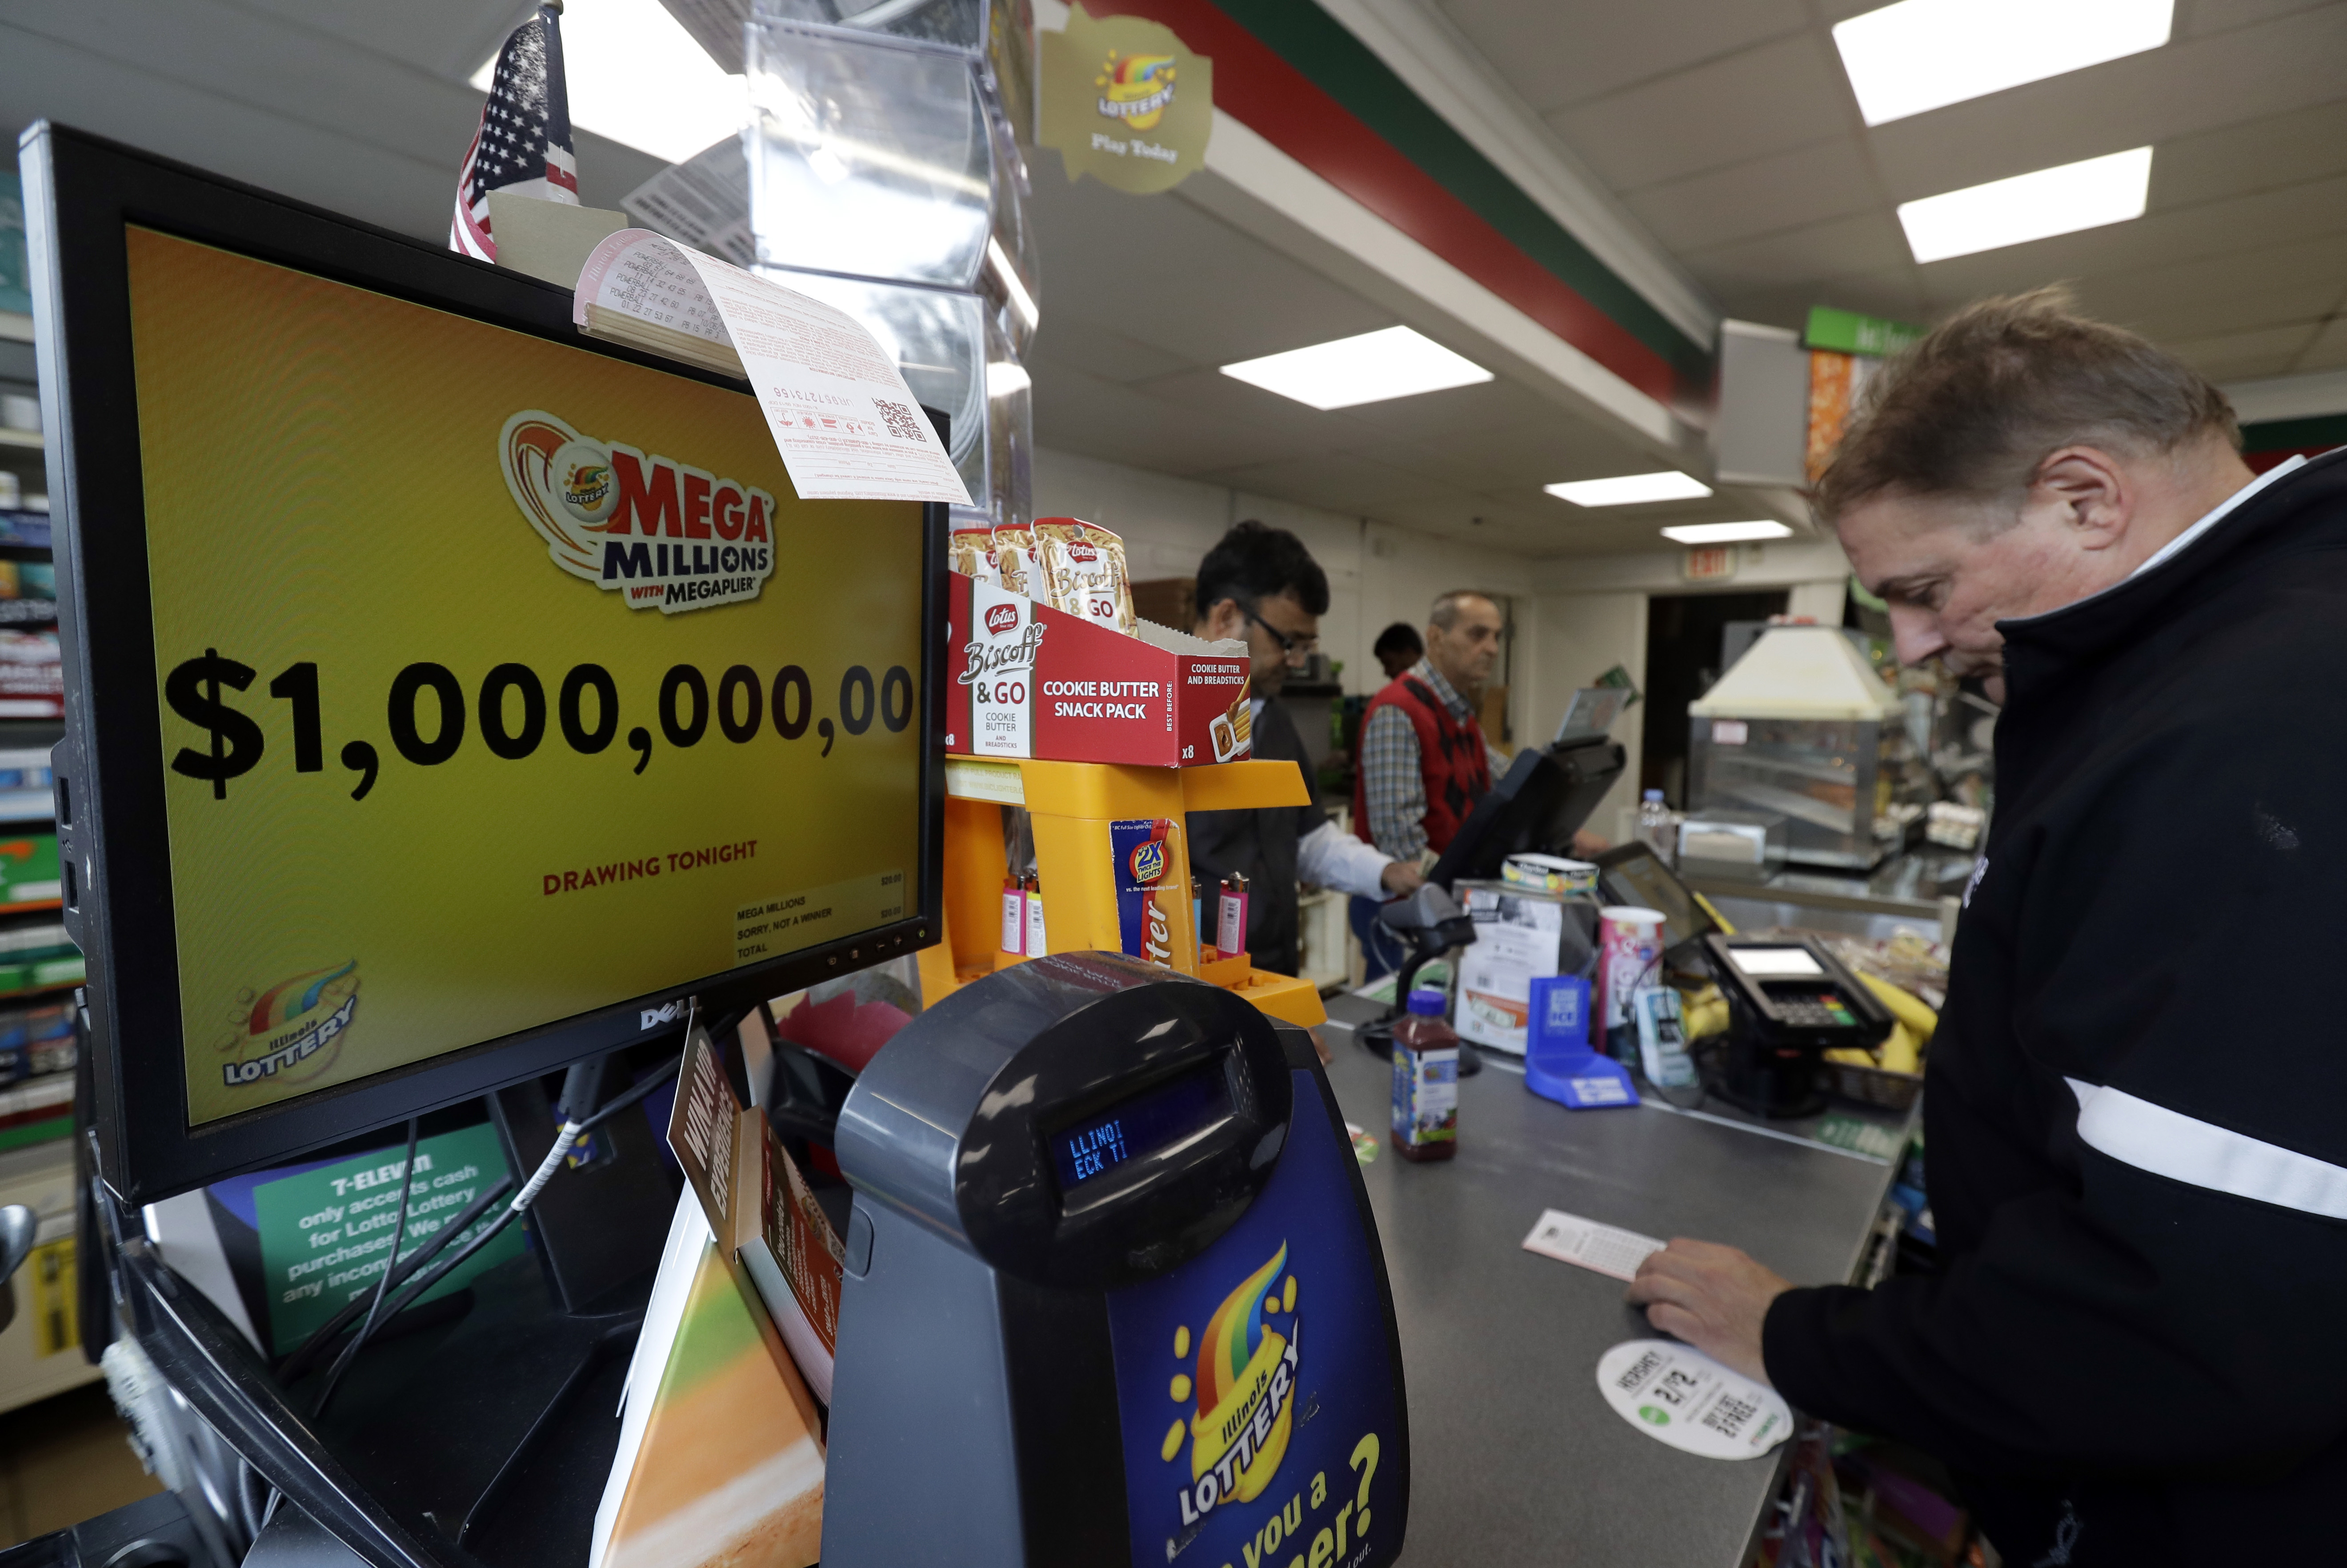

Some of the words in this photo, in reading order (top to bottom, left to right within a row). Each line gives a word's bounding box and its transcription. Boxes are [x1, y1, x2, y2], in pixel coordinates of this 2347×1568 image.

[1092, 133, 1128, 156] Play
[1130, 139, 1178, 164] Today
[589, 250, 613, 282] Illinois
[624, 261, 658, 279] POWERBALL
[633, 251, 668, 268] POWERBALL
[616, 272, 650, 291] POWERBALL
[656, 280, 666, 288] 32
[693, 294, 703, 302] PB
[609, 288, 644, 305] POWERBALL
[648, 293, 658, 301] 27
[687, 307, 696, 315] PB
[697, 310, 706, 318] 07
[632, 304, 641, 312] 22
[644, 308, 653, 316] 27
[654, 312, 663, 320] 53
[665, 315, 673, 324] 67
[681, 320, 690, 328] PB
[692, 324, 700, 332] 15
[566, 482, 609, 504] LOTTERY
[606, 450, 768, 543] MEGA
[602, 541, 768, 580] MILLIONS
[1071, 544, 1097, 557] Lotus
[1050, 560, 1121, 598] Biscoff
[630, 584, 665, 600] WITH
[665, 578, 754, 606] MEGAPLIER
[989, 606, 1016, 628] Lotus
[1086, 599, 1113, 618] GO
[957, 622, 1044, 685] Biscoff
[1187, 675, 1203, 685] AND
[1204, 676, 1245, 685] BREADSTICKS
[1191, 663, 1217, 674] COOKIE
[1218, 664, 1241, 674] BUTTER
[977, 682, 991, 704] &
[994, 681, 1025, 704] GO
[1043, 680, 1097, 696] COOKIE
[1100, 681, 1159, 698] BUTTER
[985, 712, 1017, 722] COOKIE
[1054, 702, 1103, 718] SNACK
[1105, 703, 1146, 720] PACK
[985, 722, 1017, 732] BUTTER
[1182, 745, 1194, 760] x8
[1137, 841, 1162, 867] 2X
[543, 856, 661, 896] DRAWING
[667, 840, 758, 873] TONIGHT
[1137, 864, 1151, 873] TWICE
[1137, 868, 1161, 881] LIGHTS
[737, 907, 764, 921] MEGA
[766, 896, 805, 913] MILLIONS
[737, 924, 771, 940] SORRY,
[773, 918, 790, 931] NOT
[793, 917, 798, 925] A
[800, 908, 833, 923] WINNER
[737, 944, 768, 959] TOTAL
[640, 996, 702, 1032] DELL
[223, 994, 357, 1086] LOTTERY
[269, 1019, 317, 1051] Illinois
[695, 1039, 717, 1095] VIP
[684, 1086, 712, 1171] WIN
[1069, 1119, 1123, 1159] LLINOI
[1074, 1150, 1104, 1180] ECK
[1109, 1139, 1128, 1162] TI
[299, 1205, 345, 1231] only
[433, 1165, 479, 1189] cash
[309, 1231, 340, 1249] for
[407, 1187, 477, 1219] Lottery
[407, 1217, 441, 1237] We
[283, 1280, 324, 1304] any
[1617, 1350, 1662, 1392] HERSHEY
[1222, 1369, 1269, 1444] Illinois
[1179, 1317, 1298, 1526] LOTTERY
[1242, 1492, 1302, 1568] you
[1310, 1471, 1327, 1510] a
